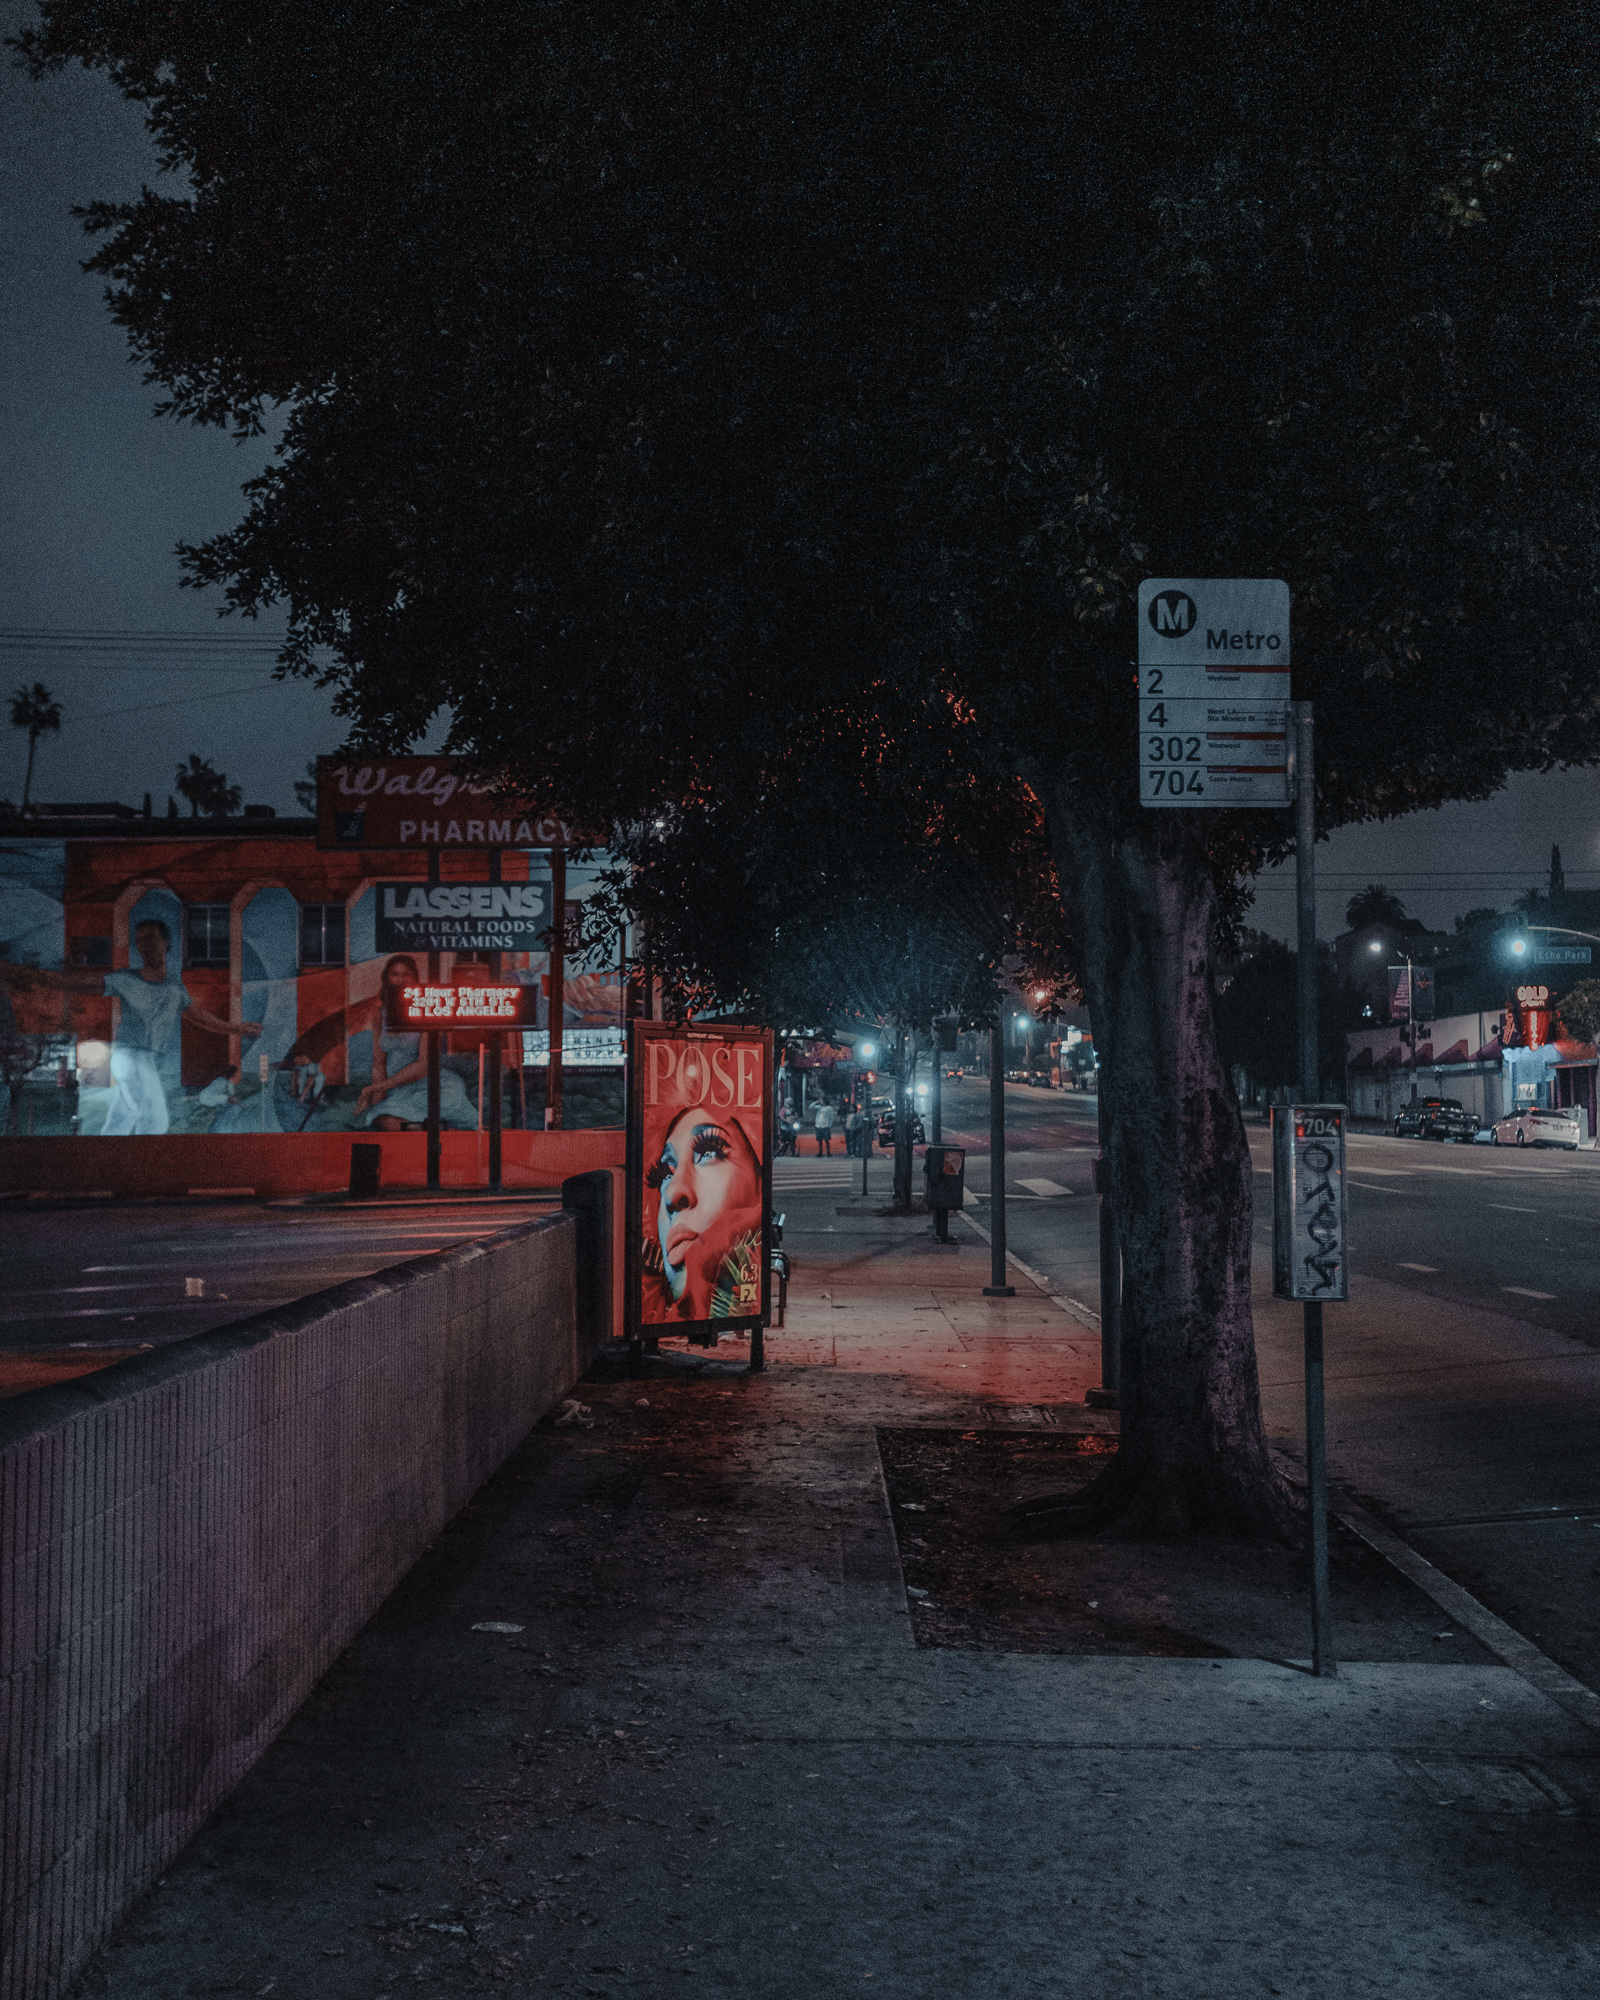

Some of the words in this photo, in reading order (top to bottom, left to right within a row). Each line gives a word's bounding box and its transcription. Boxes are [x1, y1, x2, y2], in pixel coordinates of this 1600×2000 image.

[1206, 628, 1281, 650] Metro
[1146, 668, 1164, 695] 2
[1146, 702, 1168, 728] 4
[1147, 736, 1202, 762] 302
[1148, 770, 1204, 796] 704
[383, 885, 546, 919] LASSENS
[393, 920, 474, 938] NATURAL
[476, 920, 536, 934] FOODS
[429, 935, 515, 948] VITAMINS
[1564, 951, 1588, 960] Park
[403, 987, 421, 998] 24
[424, 987, 455, 997] Hour
[457, 987, 520, 998] Pharmacy
[444, 996, 457, 1007] W
[459, 996, 484, 1007] 6TH
[1517, 985, 1549, 1001] GOLD
[424, 1006, 453, 1017] LOS
[456, 1006, 516, 1017] ANGELES
[645, 1042, 762, 1109] POSE
[1303, 1118, 1338, 1136] 704
[740, 1263, 758, 1283] 6.3
[739, 1283, 758, 1302] FX
